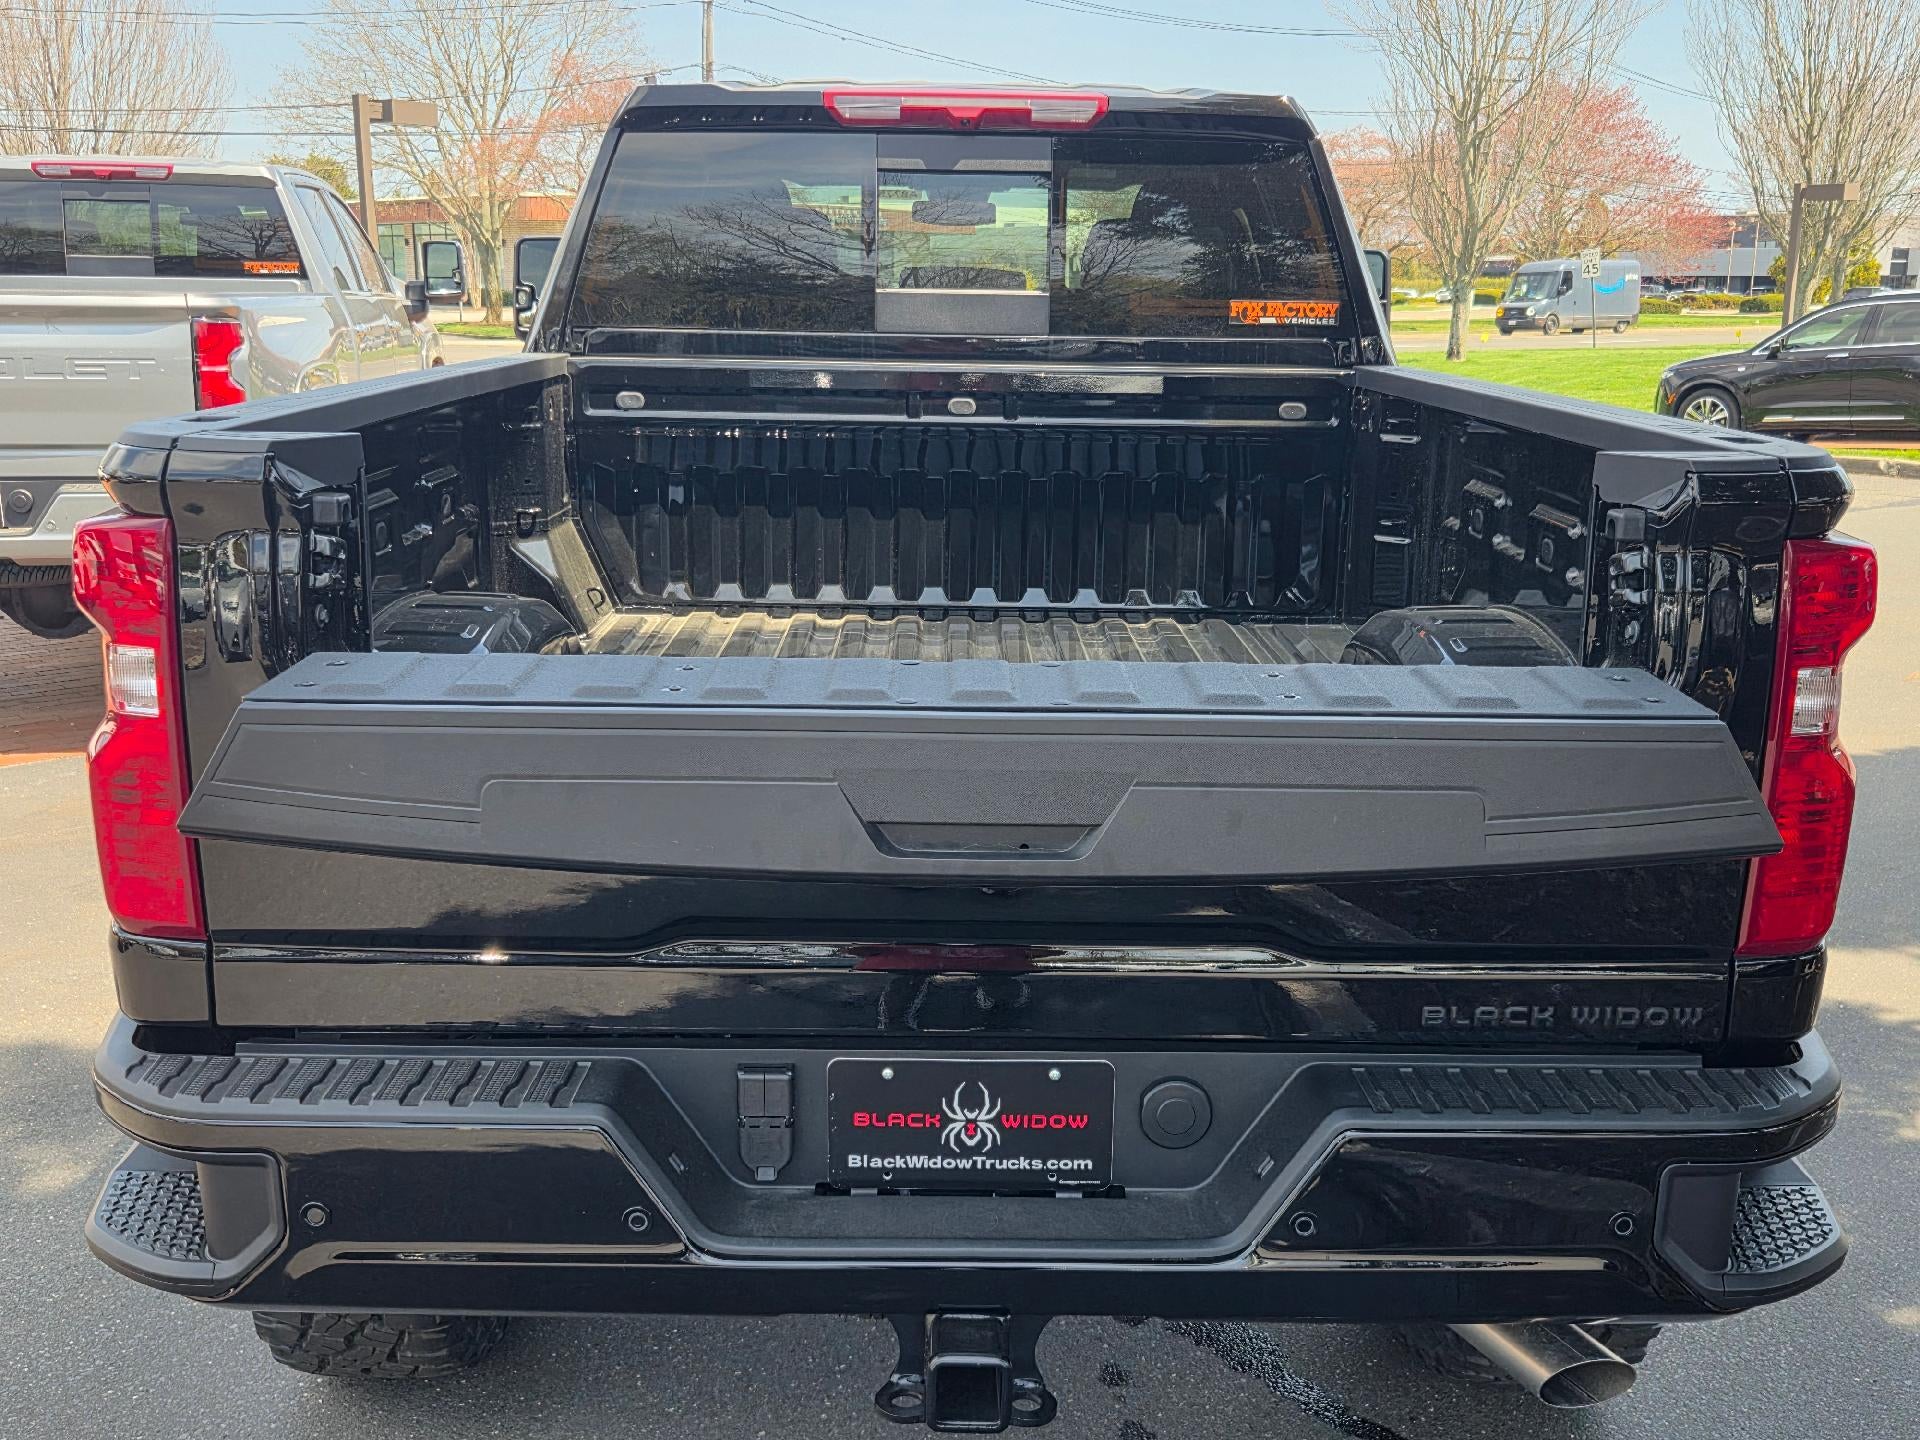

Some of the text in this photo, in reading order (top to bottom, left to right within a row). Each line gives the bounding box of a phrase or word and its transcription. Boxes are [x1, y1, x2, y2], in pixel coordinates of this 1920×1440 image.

[1583, 264, 1598, 275] 45
[1231, 301, 1339, 320] FOX FACTORY
[1284, 317, 1335, 325] VEHICLES
[1422, 1006, 1705, 1026] BLACK WIDOW
[853, 1112, 1089, 1130] BLACK WIDOW
[848, 1154, 1093, 1171] BlackWidowTrucks.com
